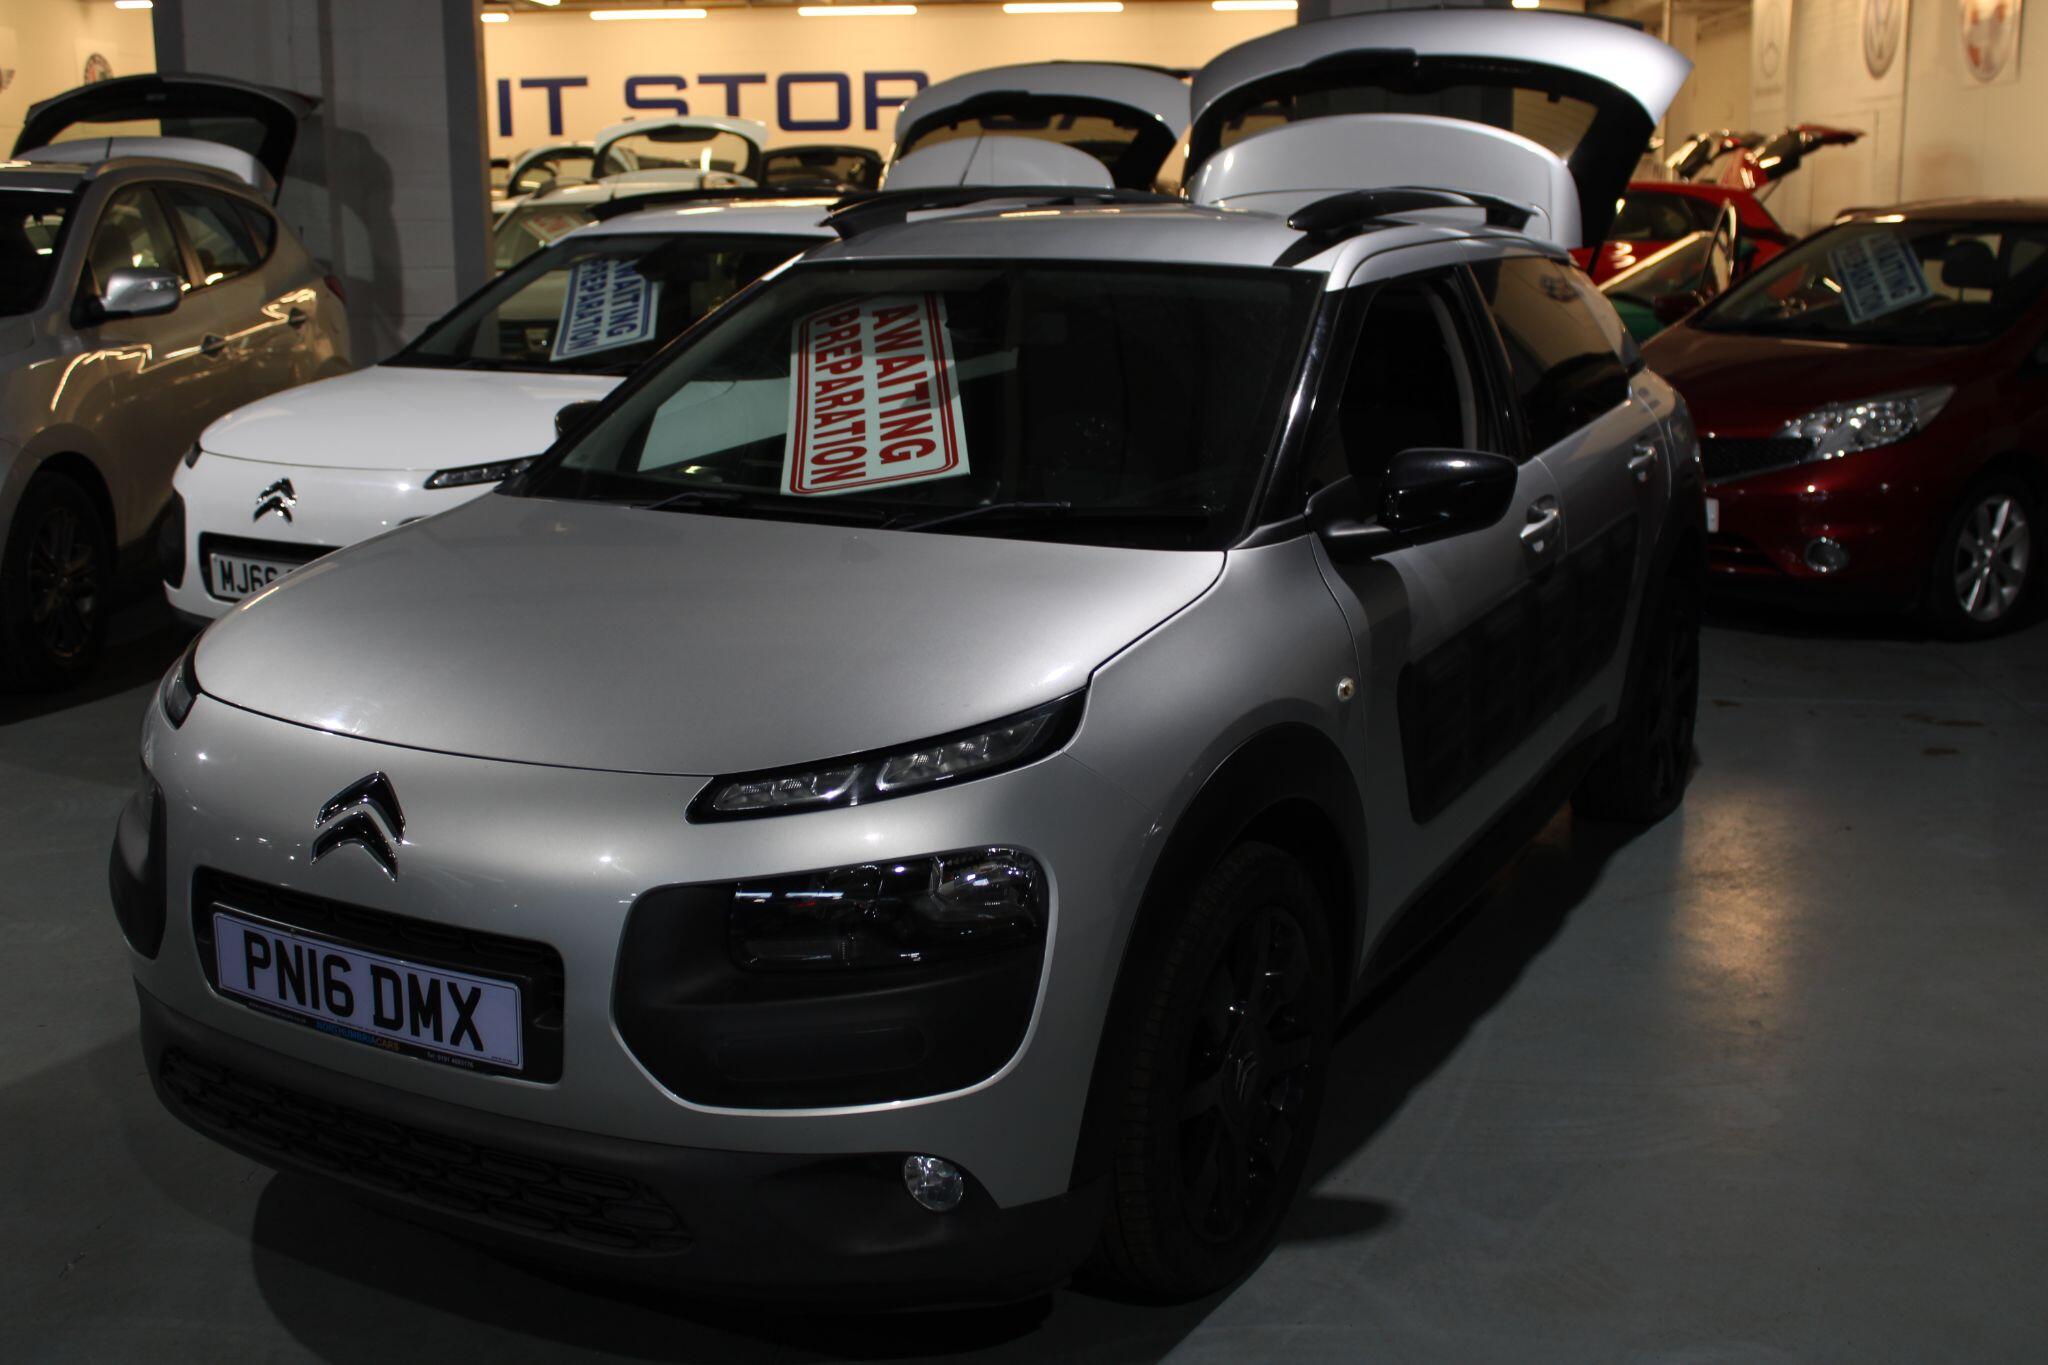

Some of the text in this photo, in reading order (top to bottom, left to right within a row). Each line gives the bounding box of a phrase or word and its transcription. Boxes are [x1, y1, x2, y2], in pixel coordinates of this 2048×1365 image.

[497, 77, 588, 137] IT
[811, 308, 867, 485] PREPARATION
[872, 304, 936, 465] AWAITING
[244, 930, 485, 1052] PN16 DMX
